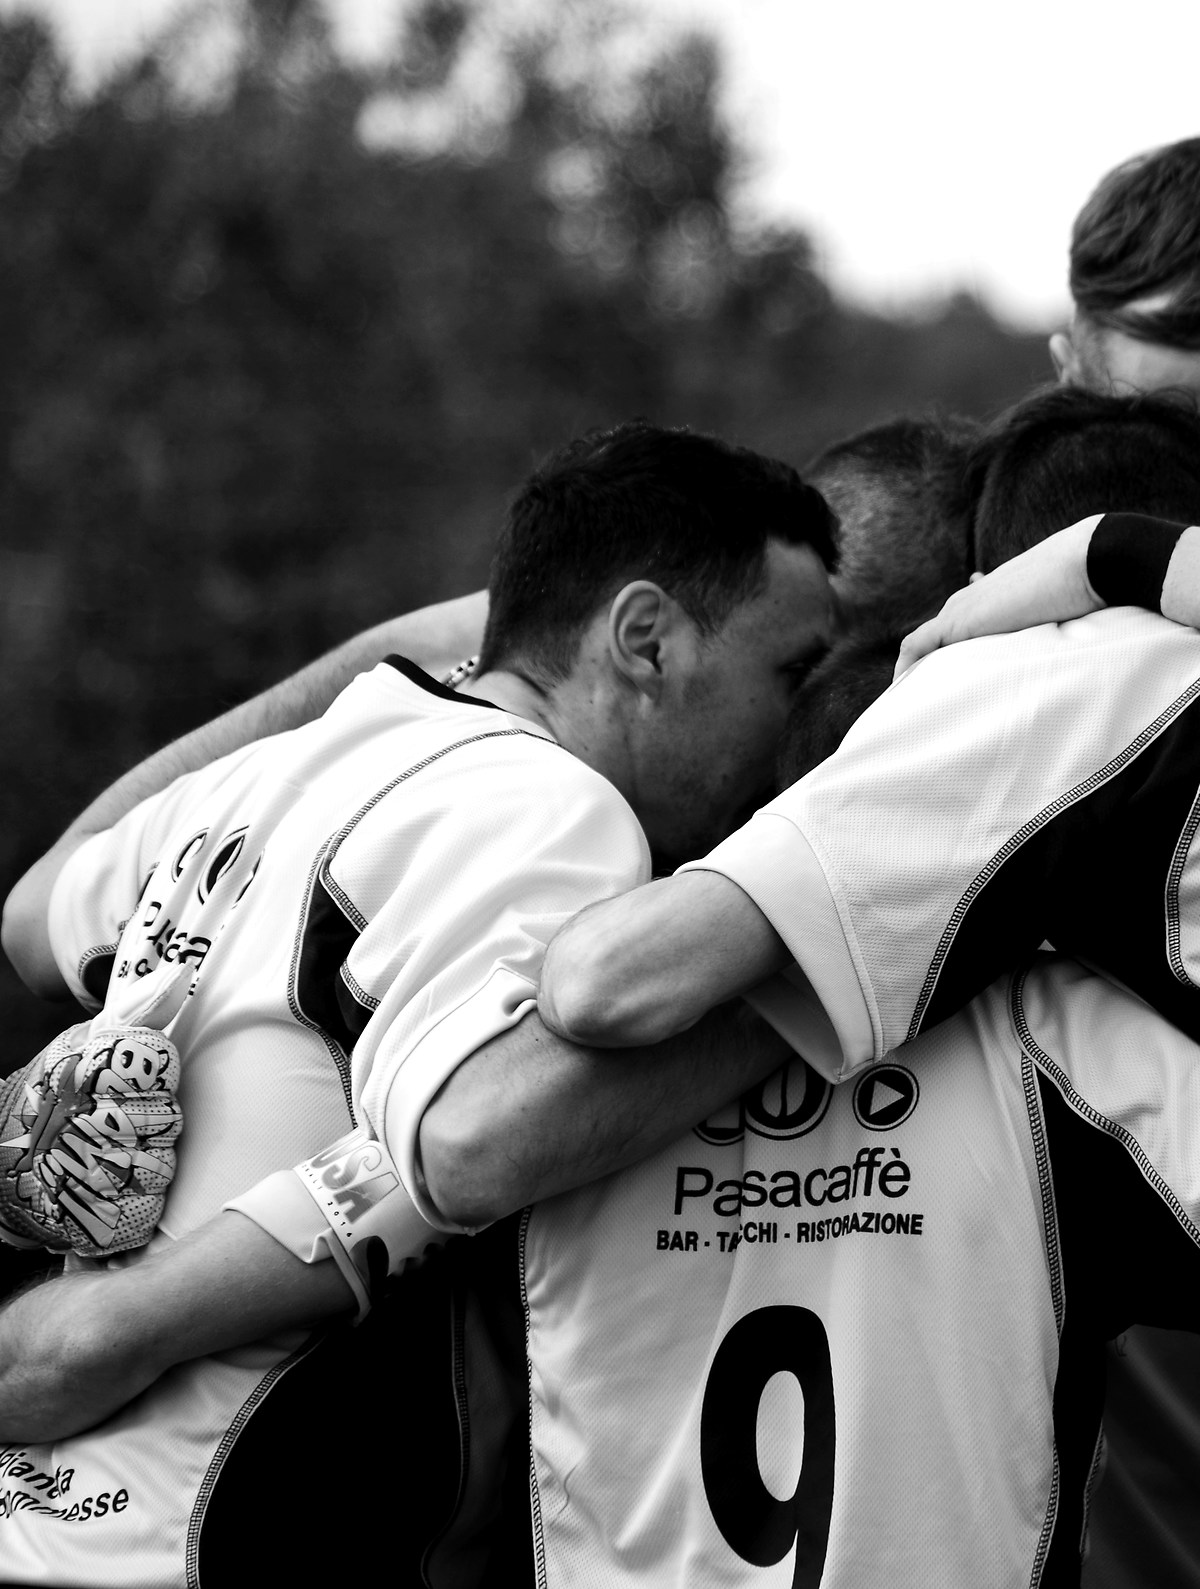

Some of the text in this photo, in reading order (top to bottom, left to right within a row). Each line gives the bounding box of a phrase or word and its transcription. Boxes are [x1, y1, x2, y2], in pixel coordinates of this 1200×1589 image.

[311, 1132, 399, 1224] USA
[656, 1230, 698, 1252] BAR
[797, 1212, 924, 1243] RISTORAZIONE
[700, 1305, 836, 1589] 9
